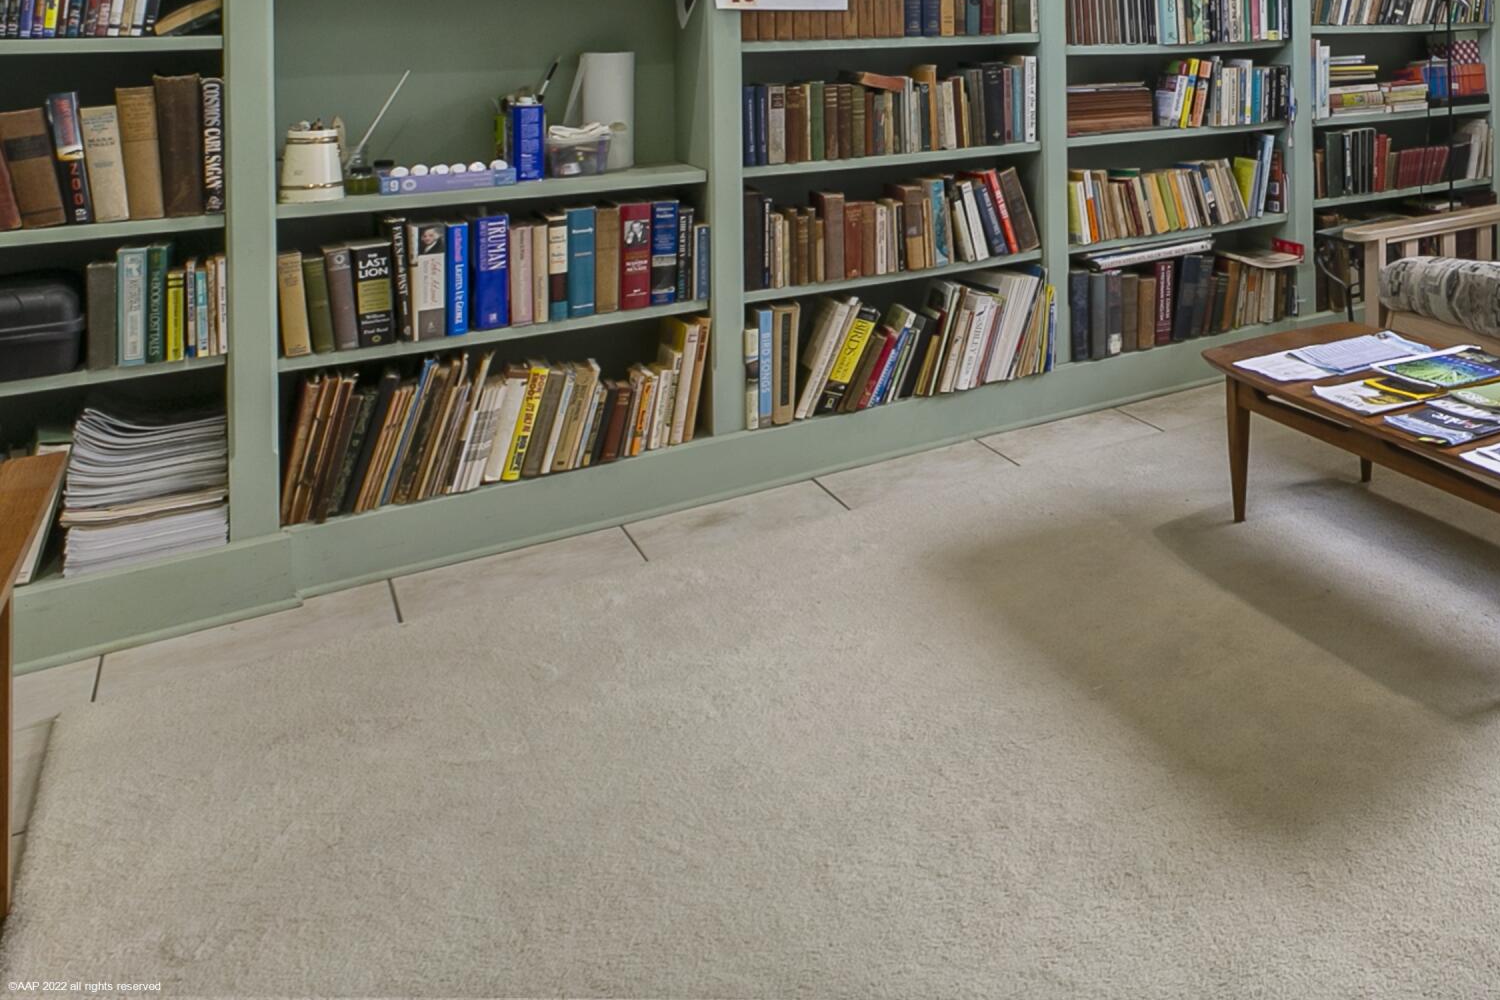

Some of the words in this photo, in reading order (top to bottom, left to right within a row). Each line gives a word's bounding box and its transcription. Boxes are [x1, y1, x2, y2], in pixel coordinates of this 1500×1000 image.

[202, 83, 219, 127] COSMOS
[204, 127, 220, 154] CARL
[204, 154, 222, 189] SAGAN
[392, 225, 404, 254] FACES
[488, 219, 506, 270] TRUMAN
[358, 257, 388, 270] LAST
[358, 267, 389, 279] LION
[397, 273, 409, 296] PAST
[150, 313, 160, 331] LOST
[150, 331, 159, 356] TALES
[762, 332, 770, 356] BIRD
[846, 318, 875, 354] BIRDS
[761, 359, 770, 393] SONGS
